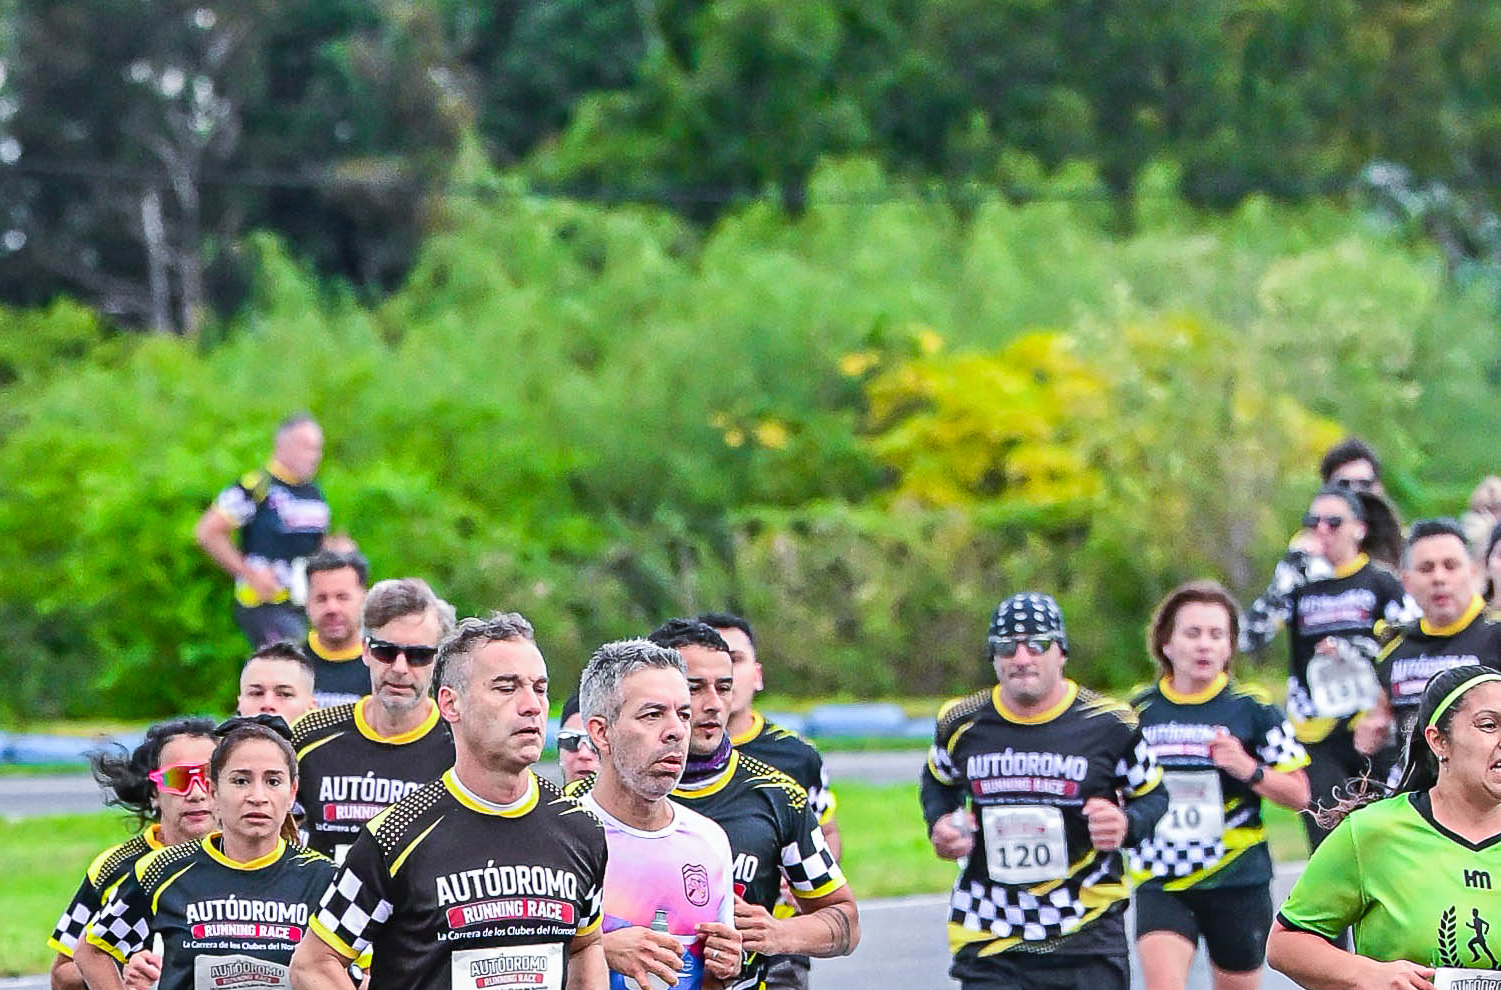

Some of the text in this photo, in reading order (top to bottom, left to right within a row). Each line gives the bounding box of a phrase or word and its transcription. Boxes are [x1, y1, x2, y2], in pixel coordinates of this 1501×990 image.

[967, 747, 1088, 781] AUTÓDROMO
[319, 770, 425, 803] AUTÓDRO
[998, 844, 1051, 869] 120
[435, 859, 578, 907] AUTÓDROMO
[186, 893, 308, 926] AUTÓDROMO
[462, 900, 563, 924] RUNNING RACE
[204, 924, 290, 940] RUNNING RACE
[437, 931, 447, 941] La
[448, 930, 481, 940] Carrera
[482, 927, 494, 937] de
[494, 926, 506, 936] los
[507, 925, 535, 935] Clubes
[537, 925, 550, 934] del
[182, 940, 190, 949] La
[191, 941, 218, 949] Carrera
[219, 941, 228, 949] de
[229, 941, 241, 949] los
[242, 942, 267, 950] Clubes
[268, 942, 280, 950] del
[210, 959, 285, 978] AUTÓDROMO
[470, 953, 548, 977] AUTÓDROMO
